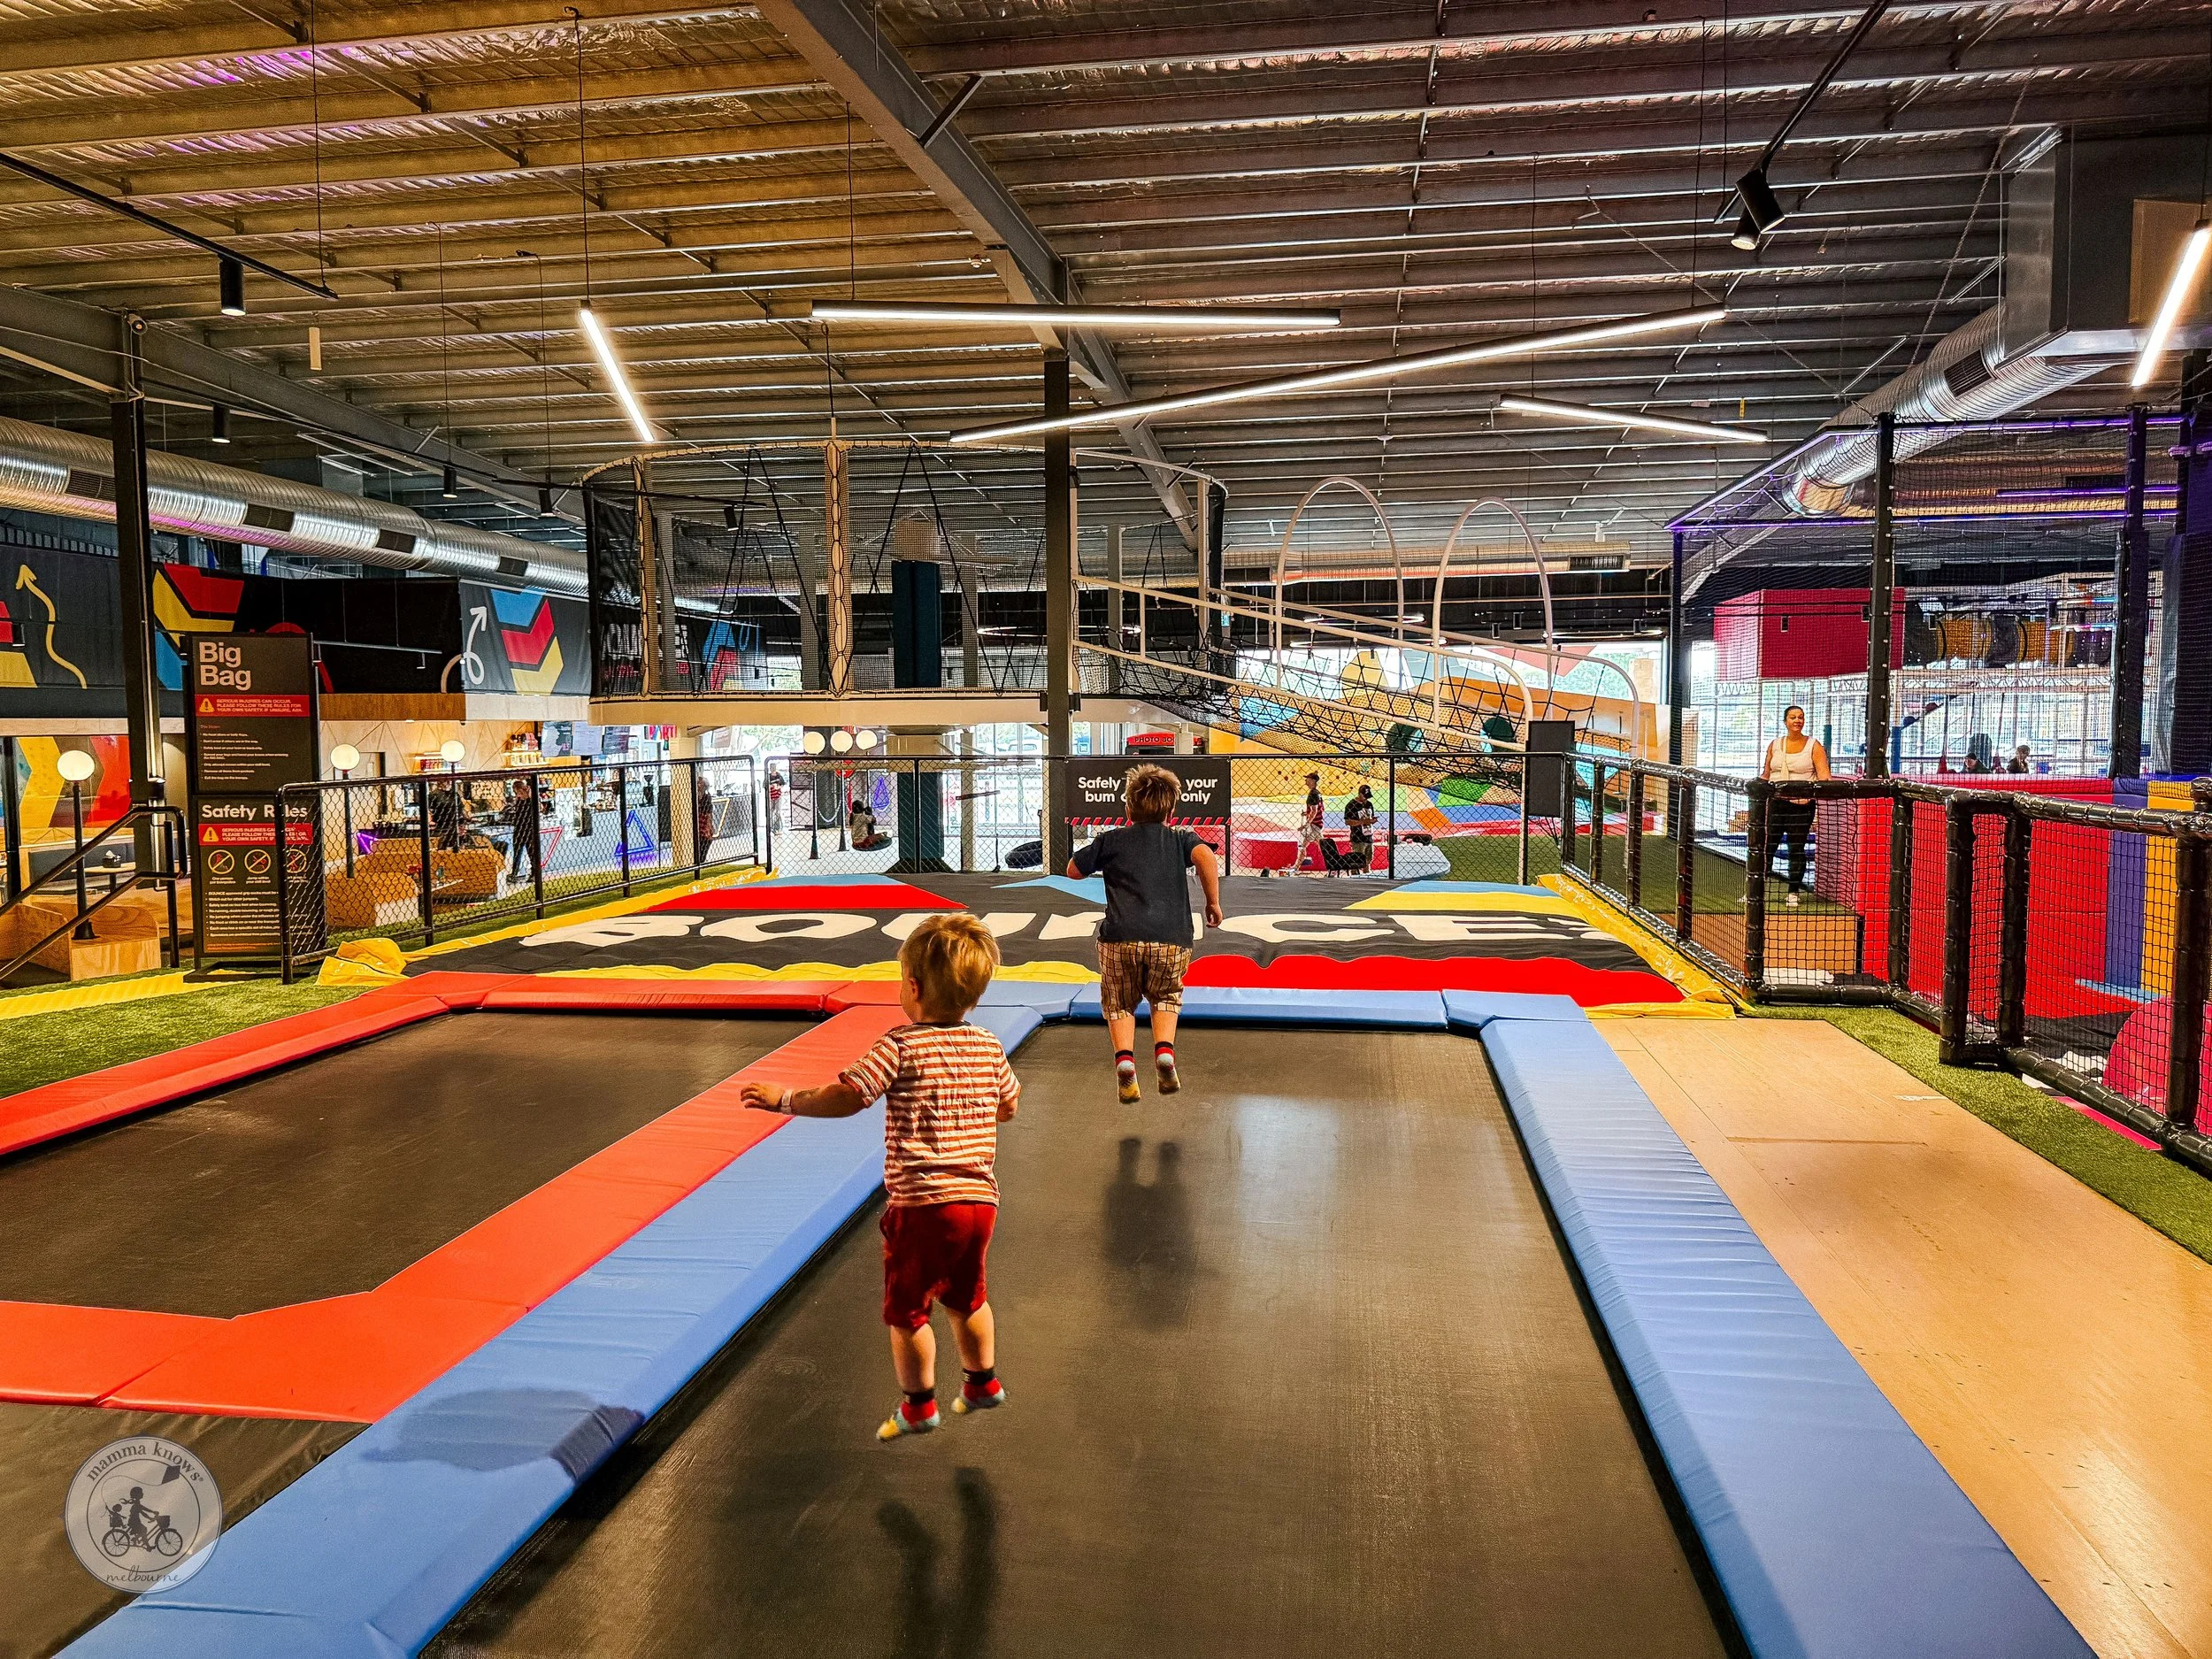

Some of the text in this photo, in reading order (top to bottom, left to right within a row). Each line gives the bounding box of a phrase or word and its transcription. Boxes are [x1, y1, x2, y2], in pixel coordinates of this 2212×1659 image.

[199, 641, 241, 668] Big
[200, 664, 251, 691] Bag
[1078, 776, 1217, 792] Safely your
[1085, 790, 1116, 803] bum
[1180, 789, 1211, 804] only
[202, 804, 308, 821] Safety Rles
